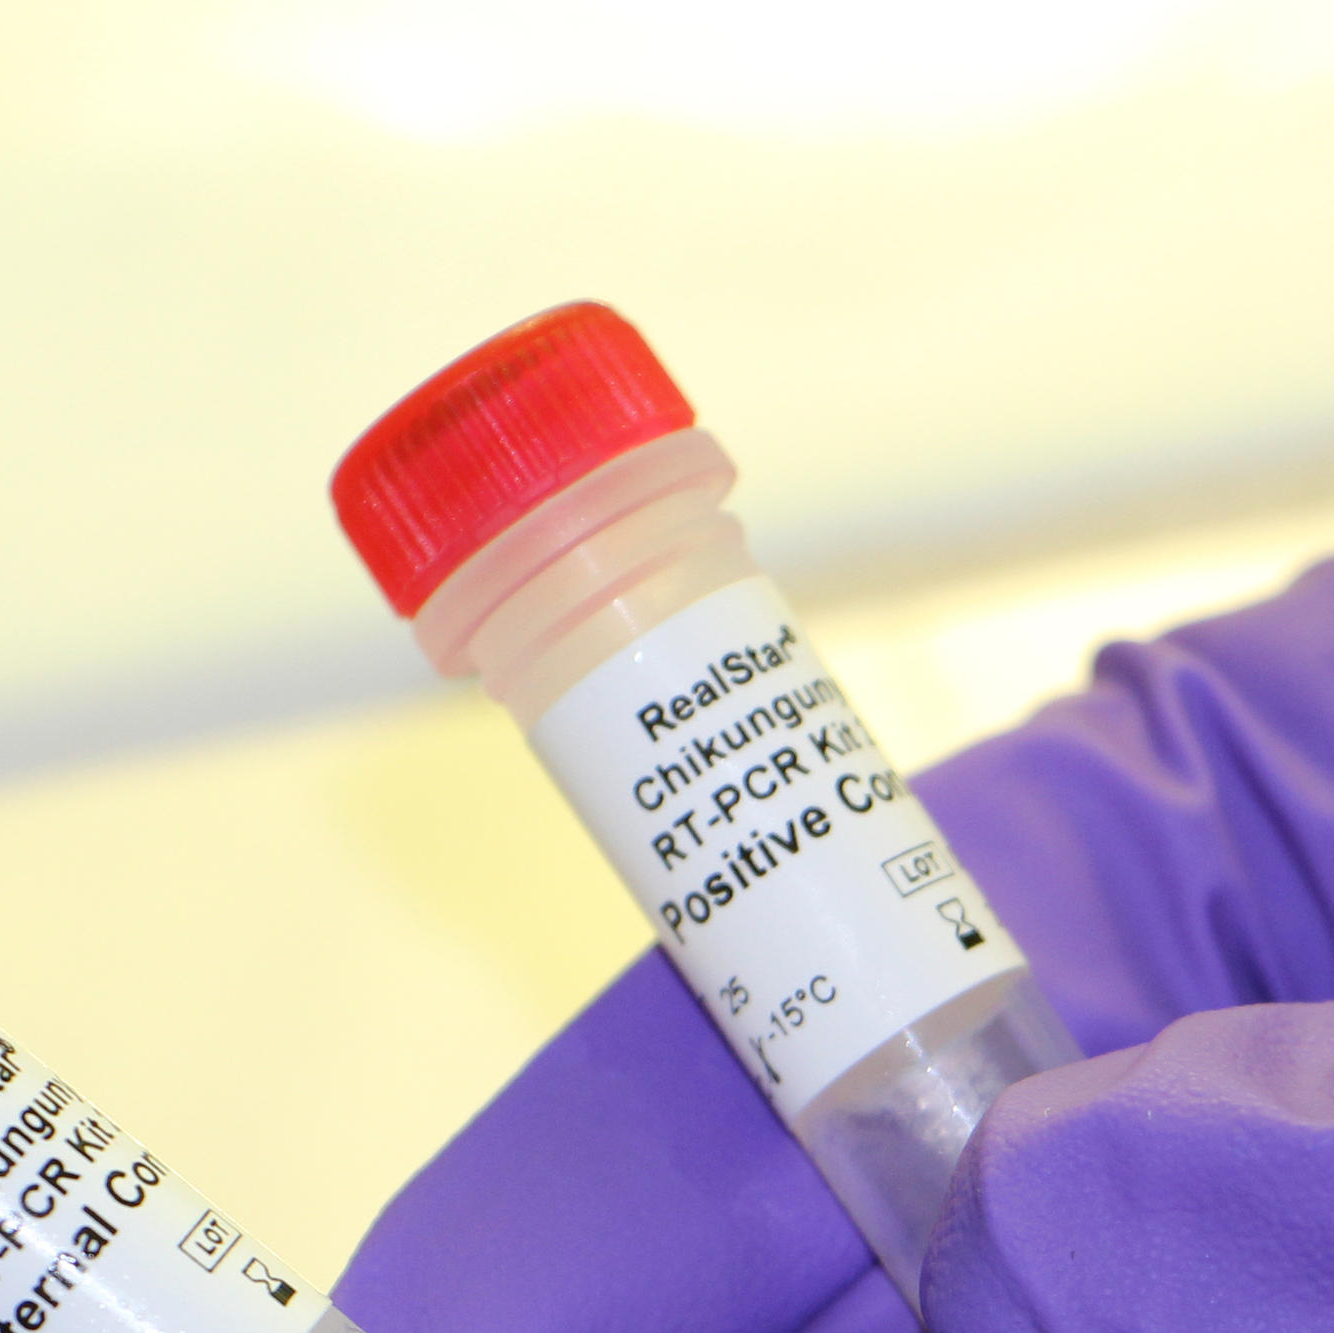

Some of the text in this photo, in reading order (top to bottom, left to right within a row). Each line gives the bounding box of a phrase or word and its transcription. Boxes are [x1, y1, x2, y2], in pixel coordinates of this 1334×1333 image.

[651, 720, 863, 871] RT-PCR Kit
[658, 805, 832, 945] Positive
[899, 851, 940, 882] LOT
[720, 975, 750, 1016] 25
[768, 974, 836, 1039] -15°C
[64, 1117, 115, 1163] Kit
[196, 1219, 229, 1256] LOT
